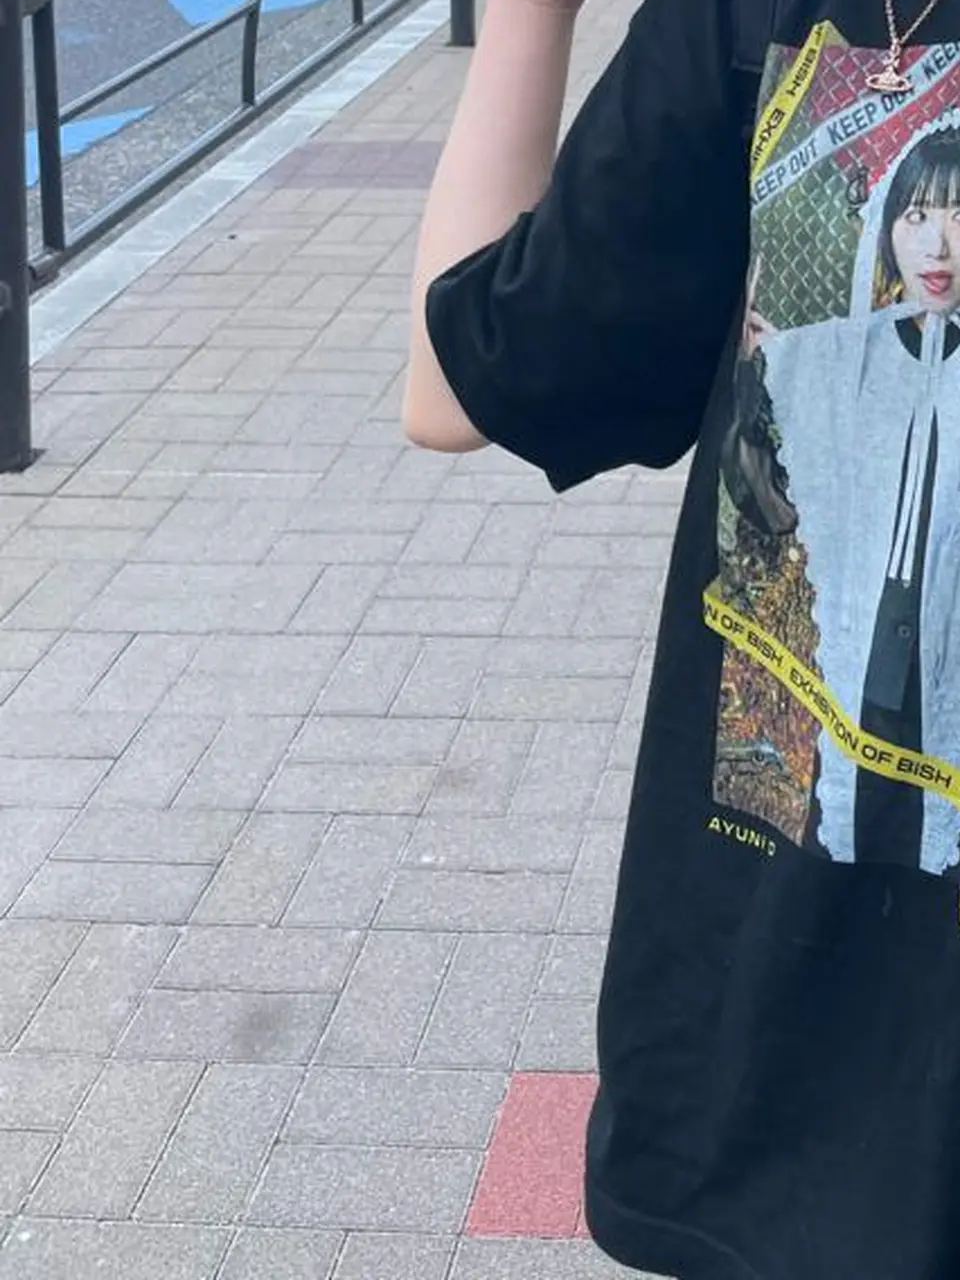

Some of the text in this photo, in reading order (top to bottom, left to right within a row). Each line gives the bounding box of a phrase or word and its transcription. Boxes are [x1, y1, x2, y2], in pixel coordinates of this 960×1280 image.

[750, 166, 786, 205] EEP
[789, 138, 817, 175] OUT
[827, 102, 877, 145] KEEP
[720, 614, 745, 638] OF
[860, 744, 893, 765] OF
